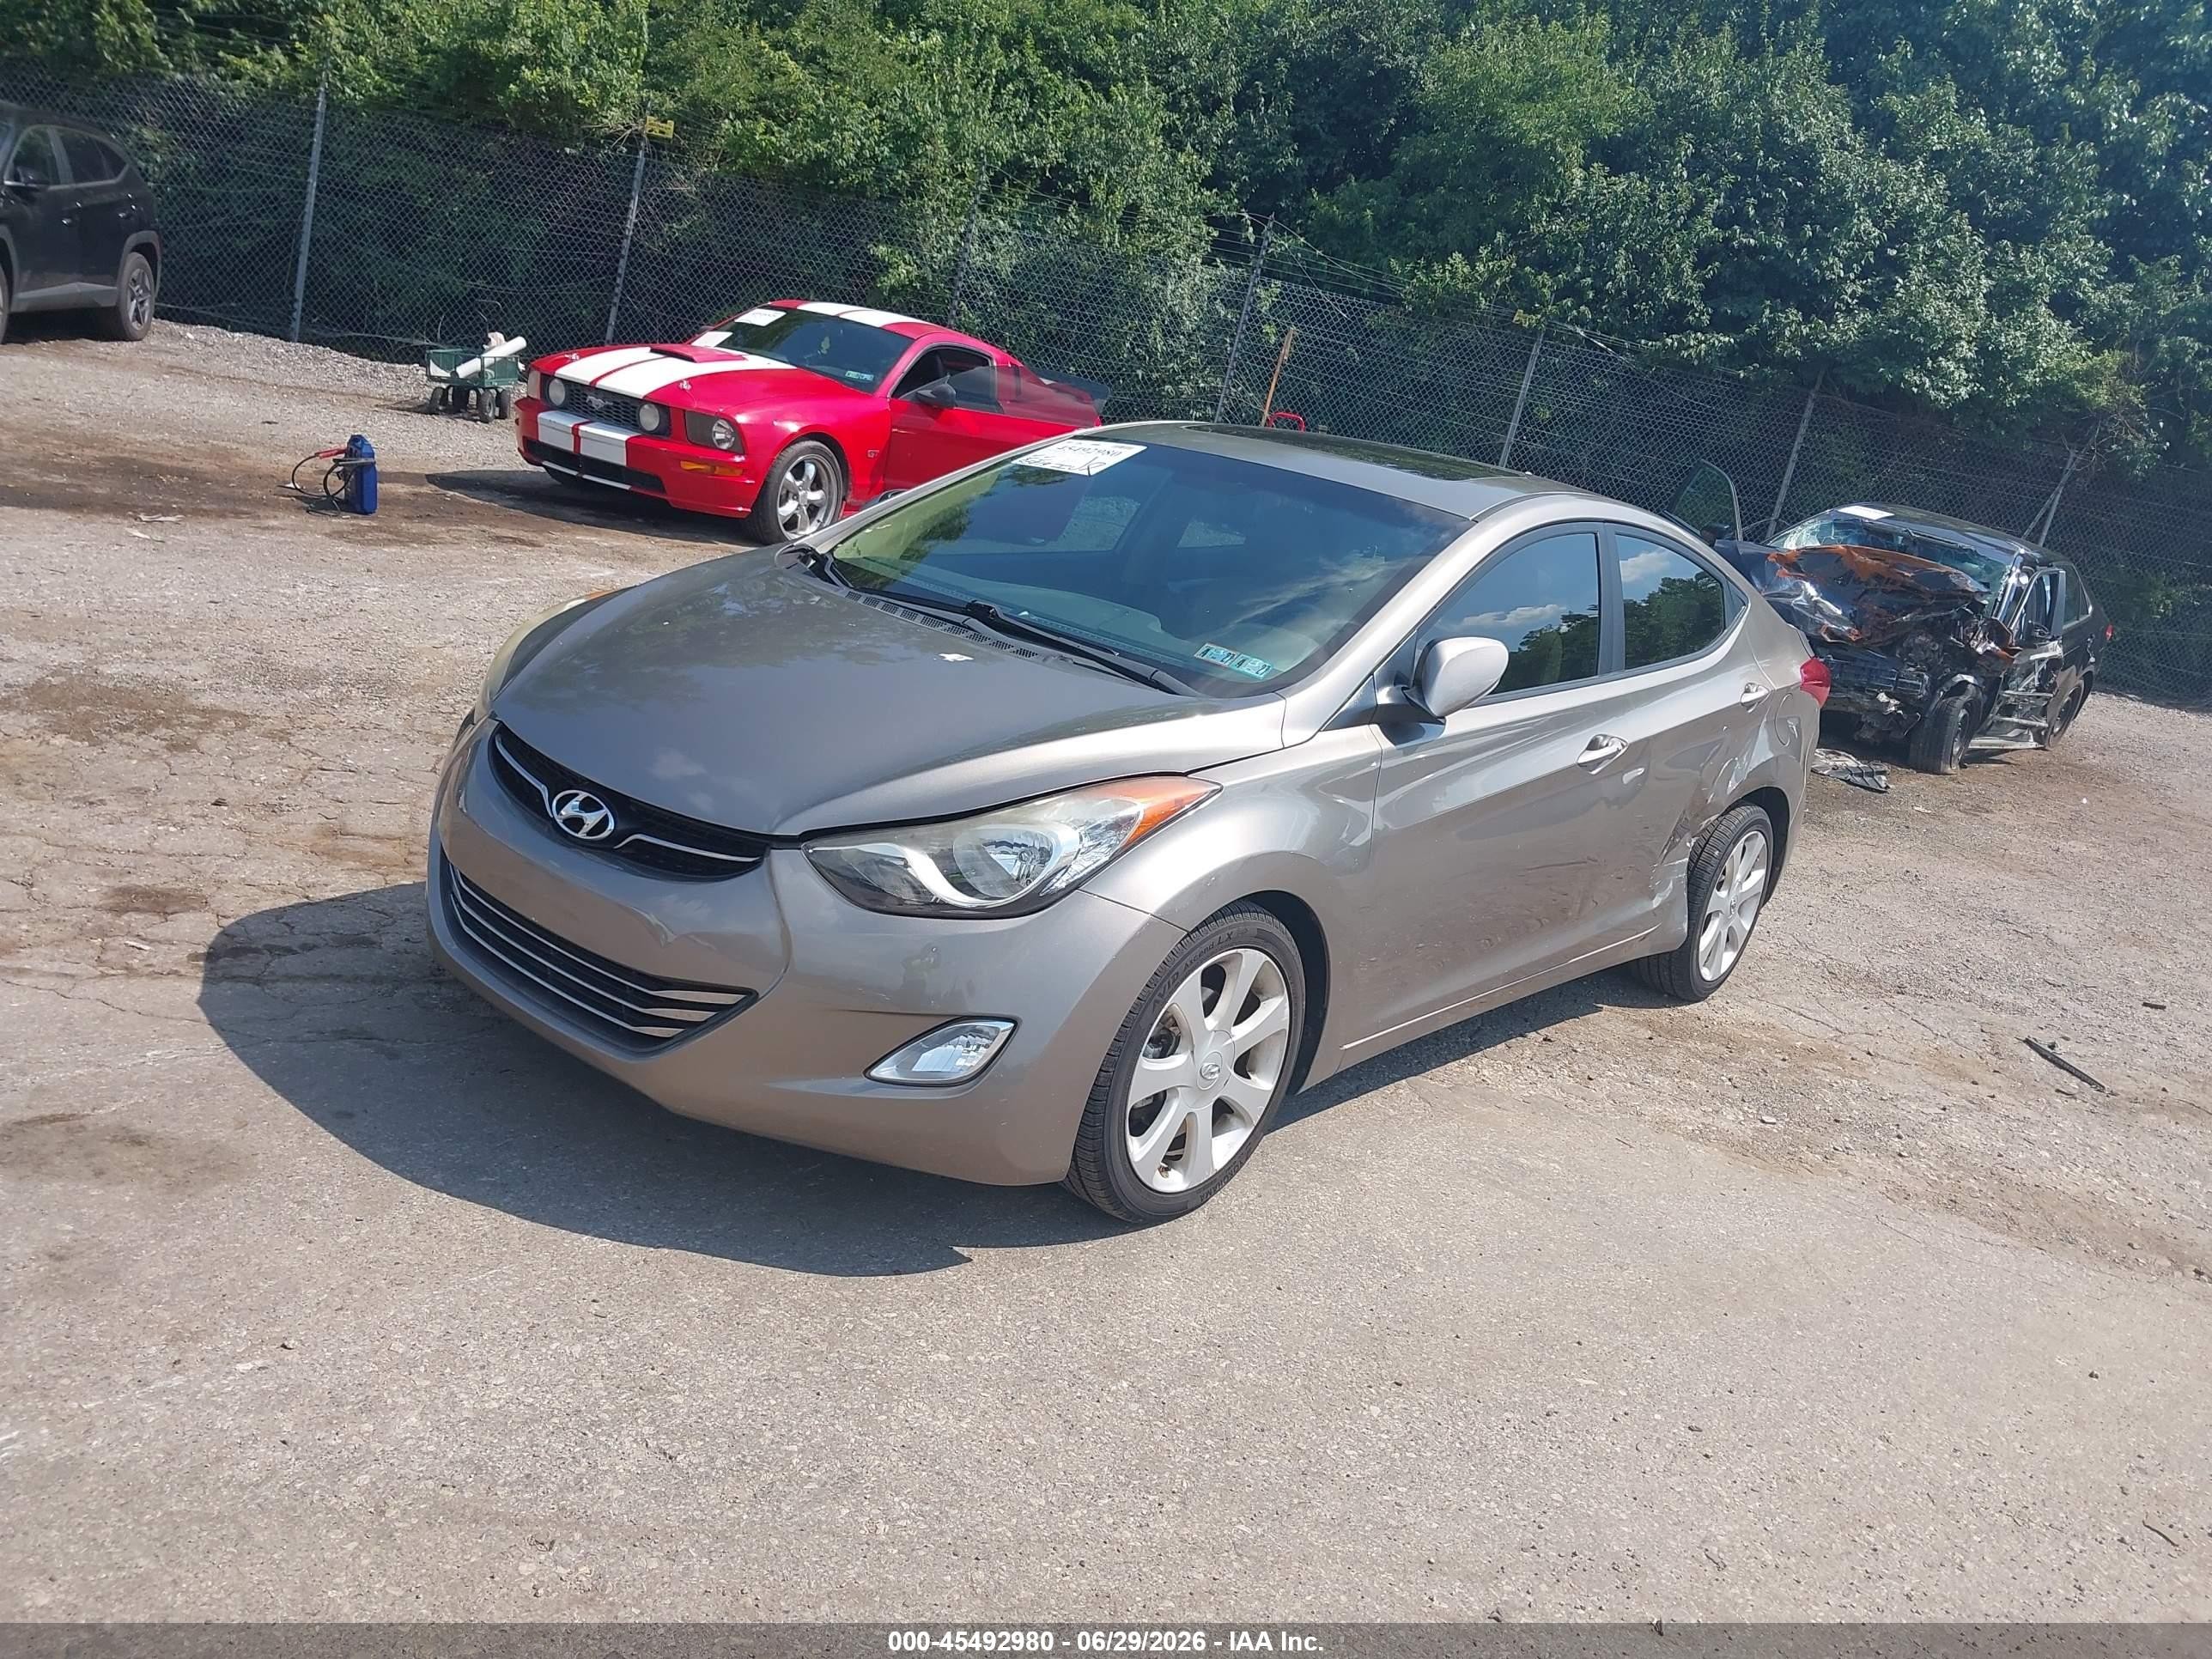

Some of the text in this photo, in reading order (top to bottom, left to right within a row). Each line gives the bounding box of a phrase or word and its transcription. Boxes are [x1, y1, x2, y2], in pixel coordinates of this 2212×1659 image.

[1152, 931, 1233, 1011] AVID Ascend LX
